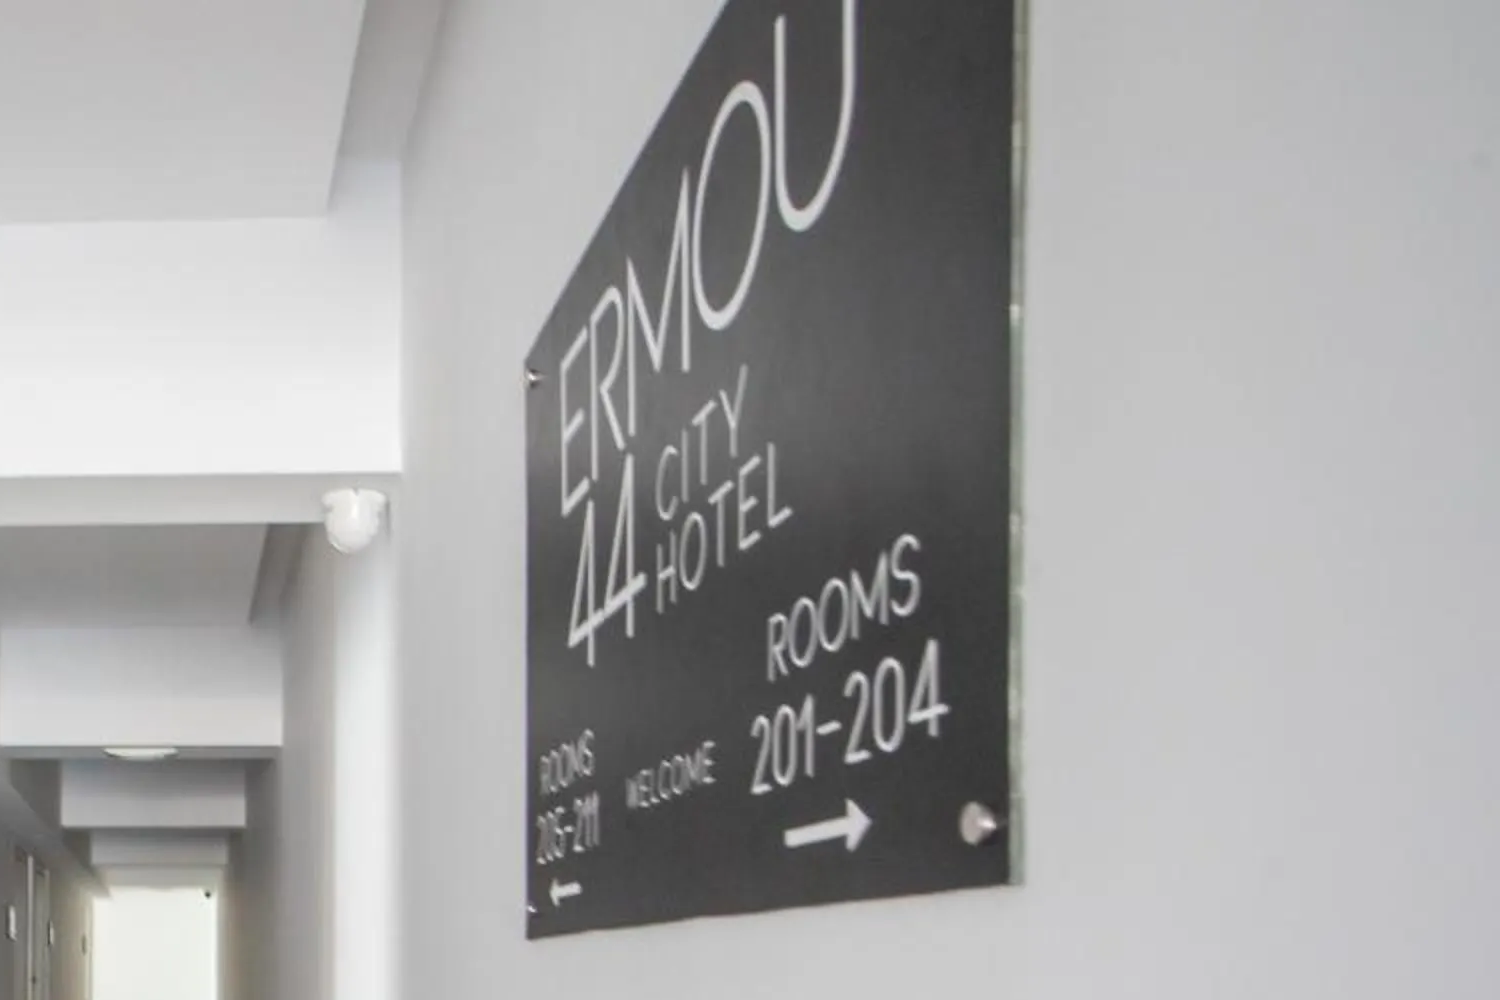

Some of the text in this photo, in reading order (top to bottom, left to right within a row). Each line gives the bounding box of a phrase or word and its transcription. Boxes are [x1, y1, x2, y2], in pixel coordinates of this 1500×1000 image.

[560, 0, 854, 517] ERMOU
[656, 364, 748, 520] CITY
[568, 453, 647, 667] 44
[656, 442, 792, 614] HOTEL
[767, 534, 921, 682] ROOMS
[539, 728, 595, 796] ROOMS
[625, 739, 716, 810] WELCOME
[750, 639, 950, 795] 201-204
